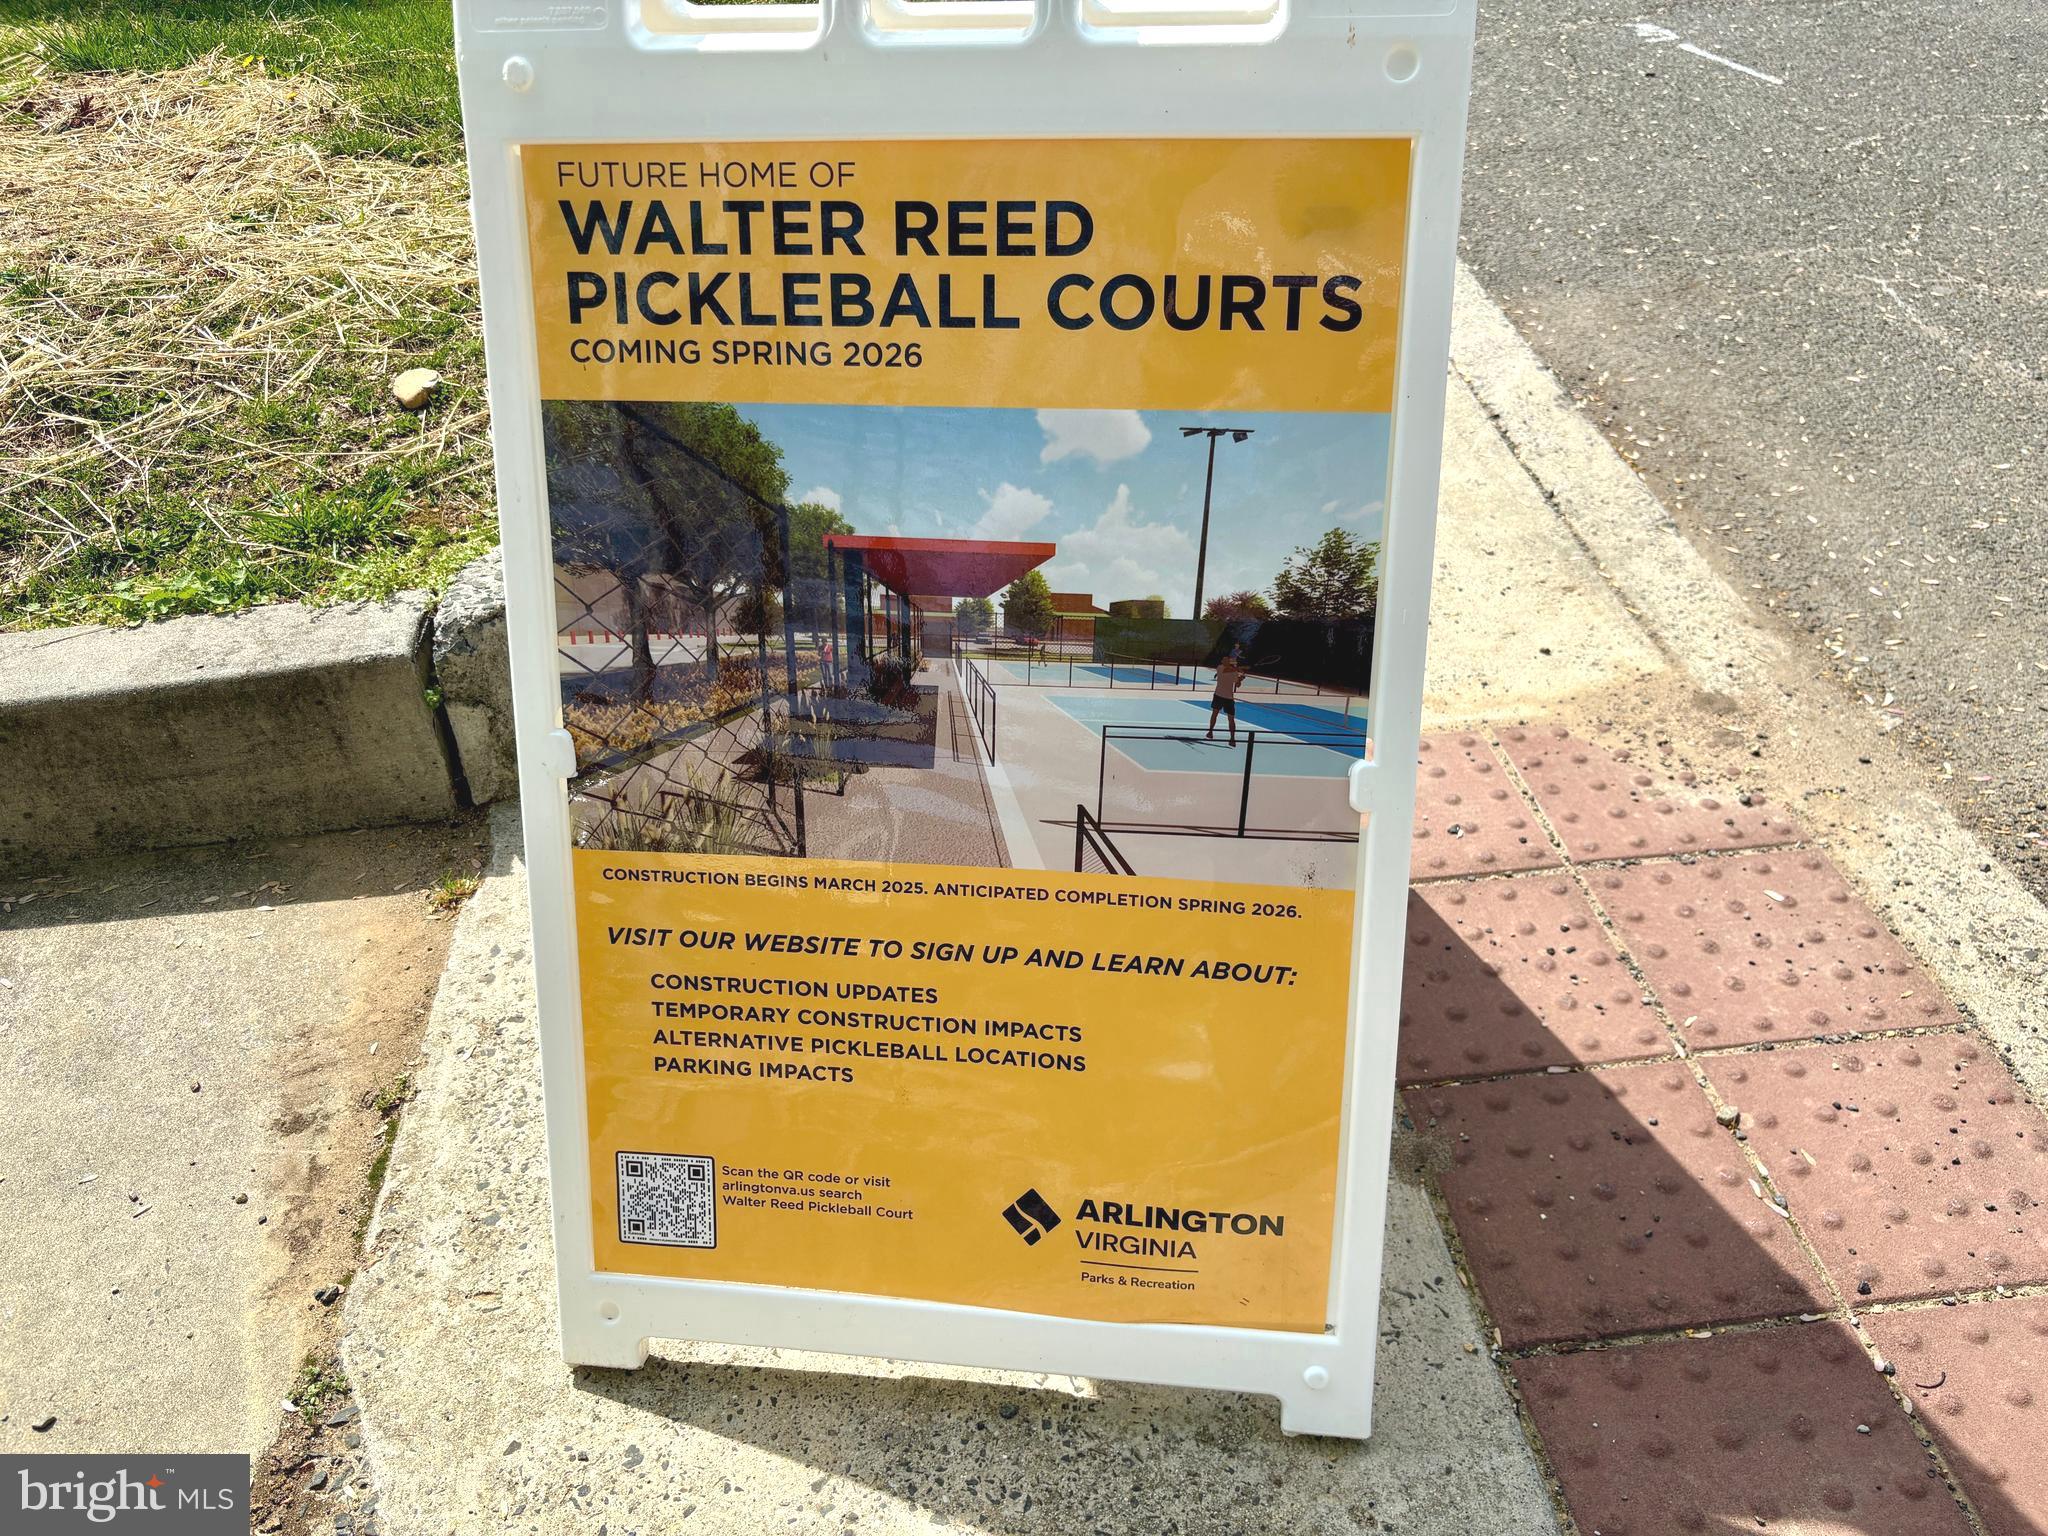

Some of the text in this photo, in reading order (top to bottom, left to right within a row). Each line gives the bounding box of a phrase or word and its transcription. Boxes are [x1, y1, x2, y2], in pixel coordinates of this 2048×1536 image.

[557, 161, 856, 188] FUTURE HOME OF
[557, 199, 1094, 257] WALTER REED
[566, 270, 1363, 333] PICKLEBALL COURTS
[570, 338, 923, 368] COMING SPRING 2026
[602, 867, 1302, 919] CONSTRUCTION BEGINS MARCH 2025. ANTICIPATED COMPLETION SPRING 2026.
[608, 926, 1298, 986] VISIT OUR WEBSITE TO SIGN UP AND LEARN ABOUT:
[650, 973, 938, 1004] CONSTRUCTION UPDATES
[651, 1001, 1082, 1043] TEMPORARY CONSTRUCTION IMPACTS
[652, 1029, 1086, 1072] ALTERNATIVE PICKLEBALL LOCATIONS
[654, 1056, 854, 1083] PARKING IMPACTS
[722, 1165, 891, 1188] Scan the QR code or visit
[722, 1180, 862, 1201] arlingtonva.us search
[722, 1194, 913, 1220] Walter Reed Pickleball Court
[1075, 1198, 1285, 1237] ARLINGTON
[1075, 1229, 1197, 1259] VIRGINIA
[1081, 1271, 1195, 1290] Parks & Recreation
